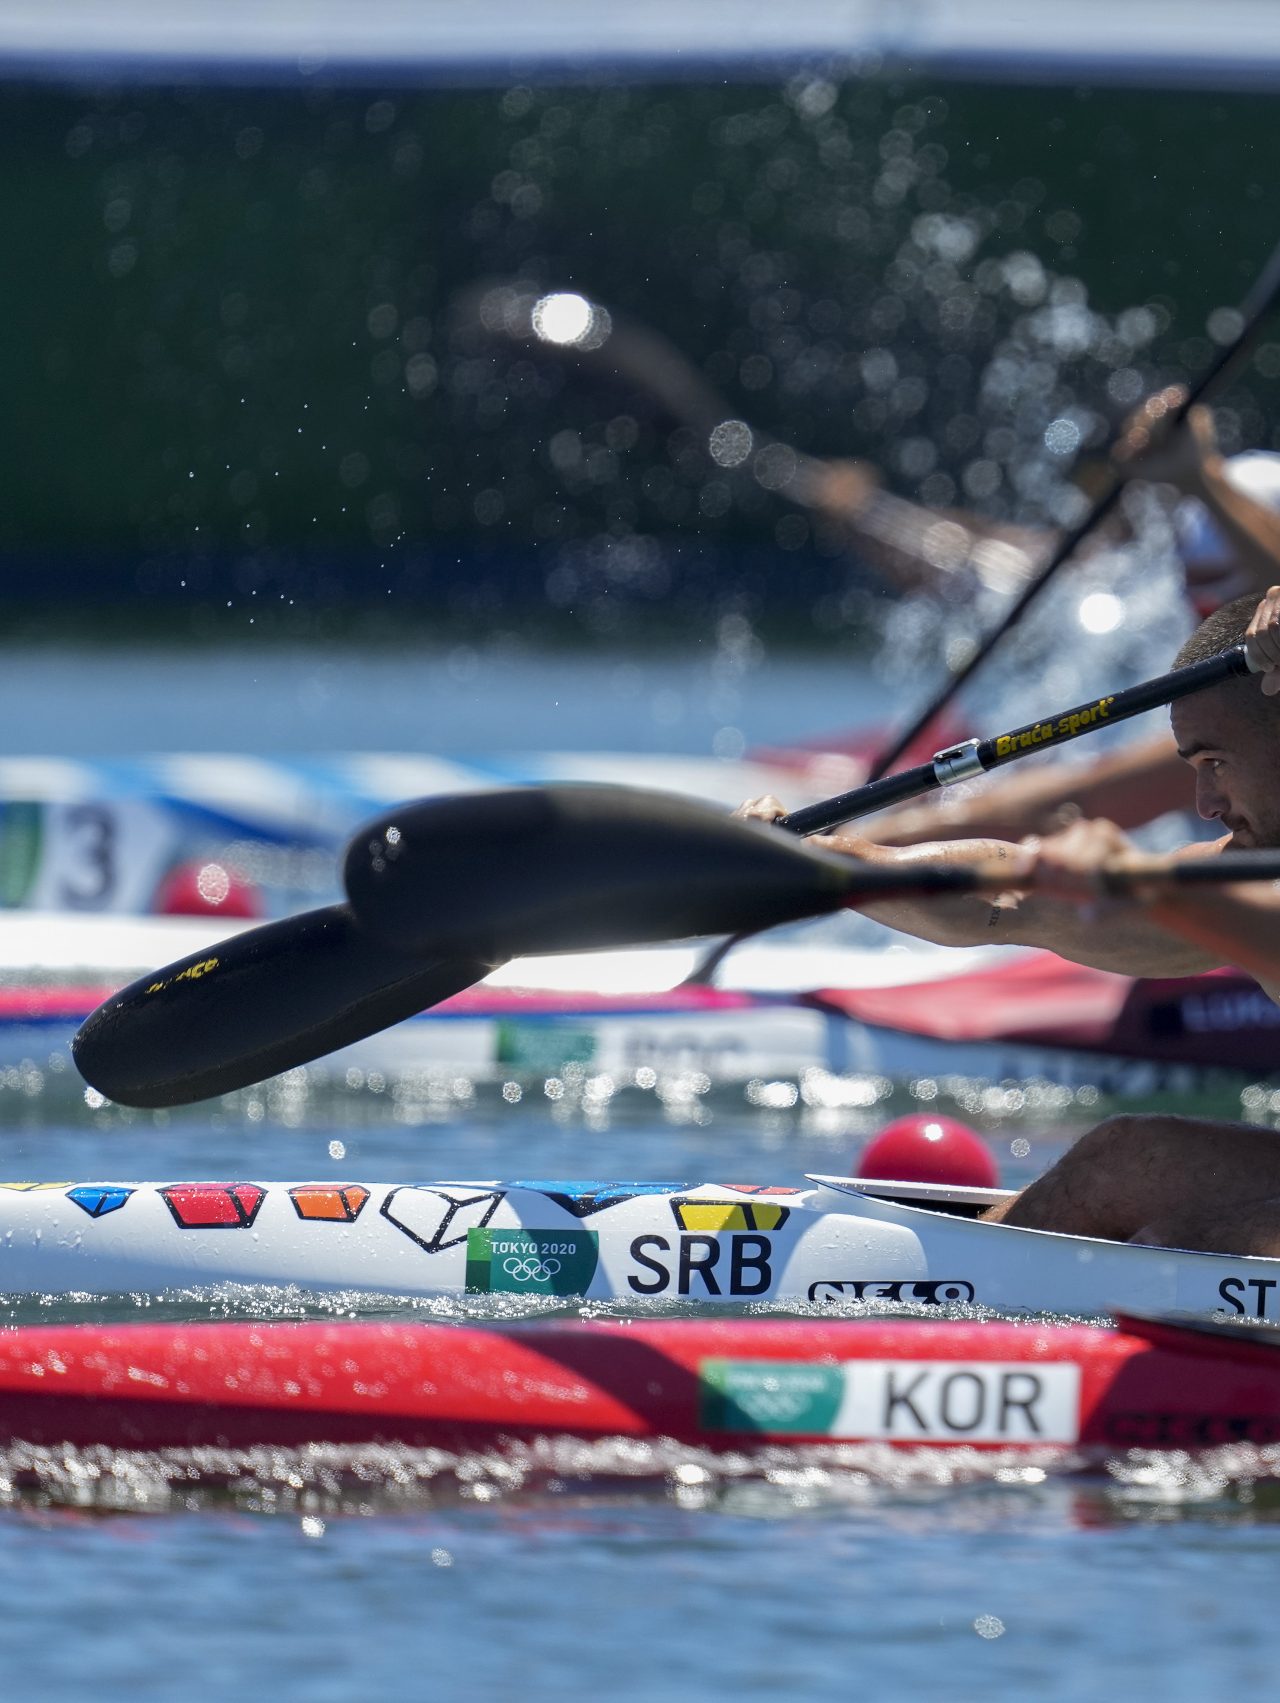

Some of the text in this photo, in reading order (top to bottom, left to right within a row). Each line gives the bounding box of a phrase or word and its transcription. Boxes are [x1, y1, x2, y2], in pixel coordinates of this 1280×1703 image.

[60, 804, 118, 908] 3
[490, 1242, 577, 1255] TOKYO 2020
[628, 1234, 772, 1296] SRB
[813, 1282, 972, 1304] NELO
[882, 1371, 1042, 1433] KOR
